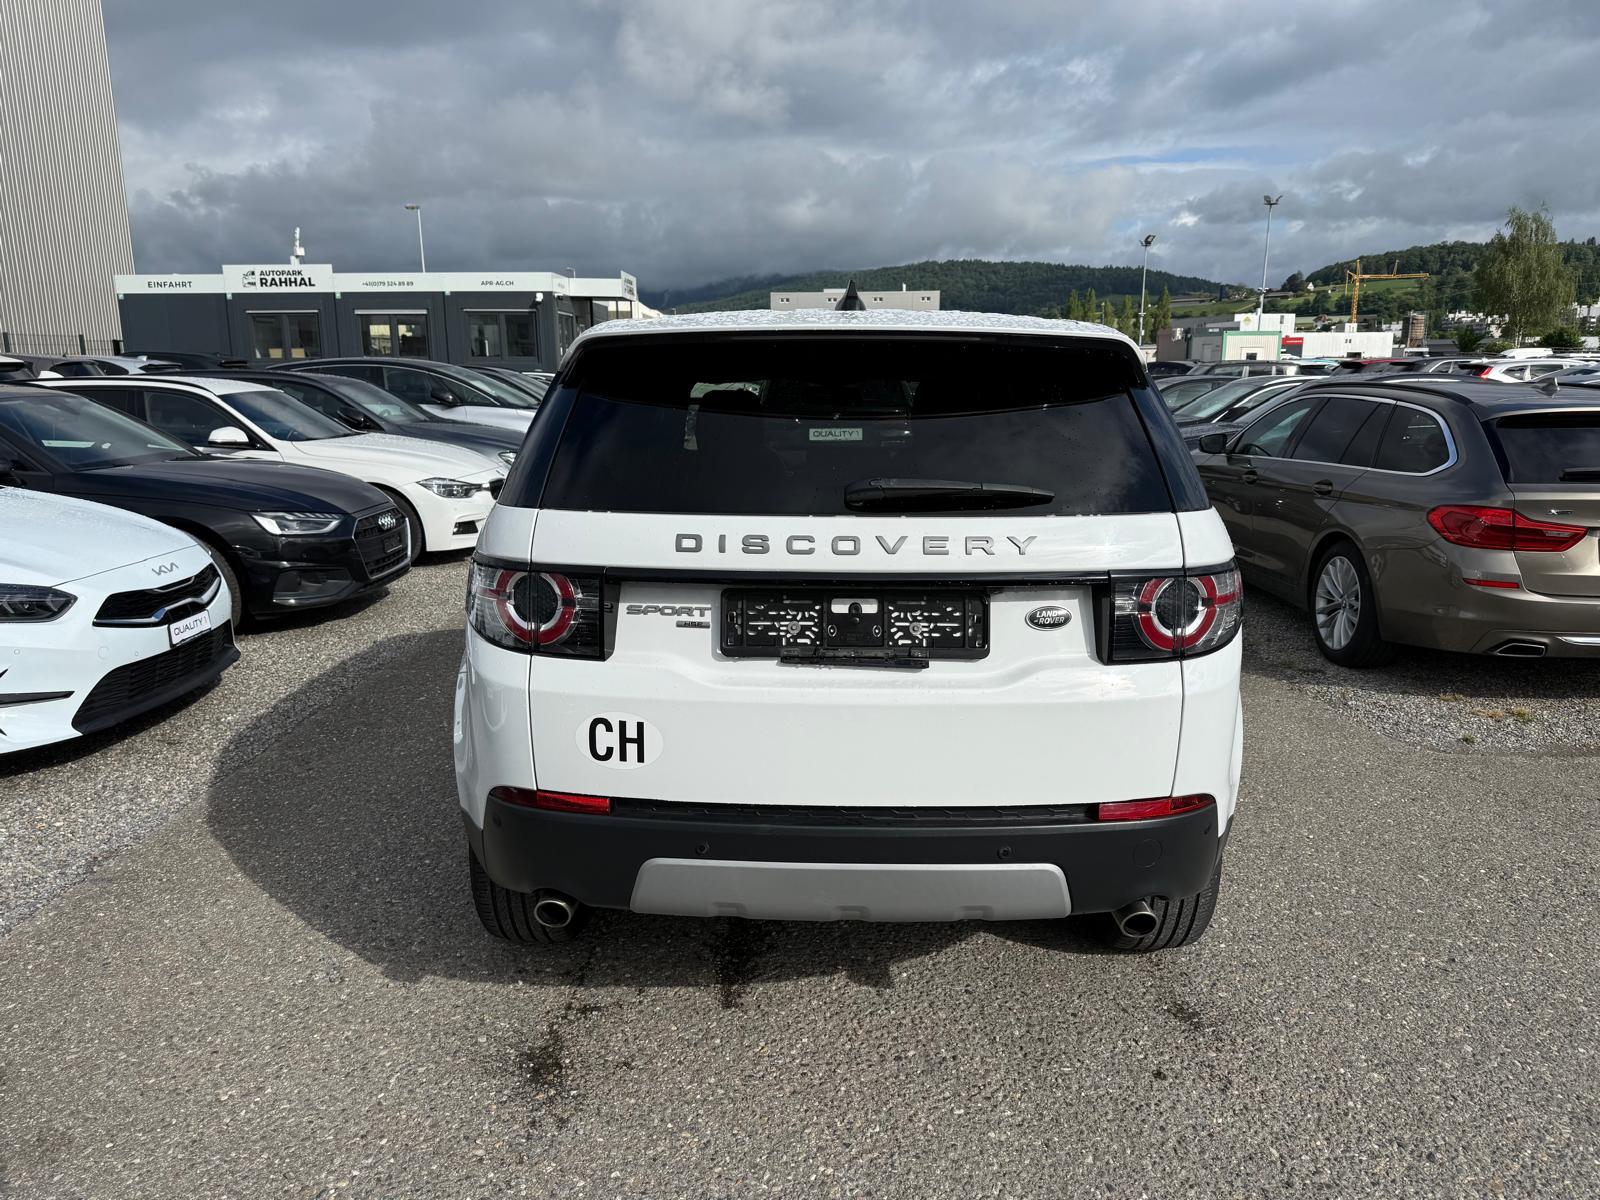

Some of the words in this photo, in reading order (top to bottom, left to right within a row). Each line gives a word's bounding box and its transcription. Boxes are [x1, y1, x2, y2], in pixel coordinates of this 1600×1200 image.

[260, 277, 316, 287] RAHHAL
[675, 533, 1038, 556] DISCOVERY
[626, 604, 712, 617] SPORT
[1036, 610, 1057, 618] LAND
[173, 617, 202, 636] QUALITY
[1038, 616, 1065, 625] ROVER
[588, 717, 645, 763] CH
